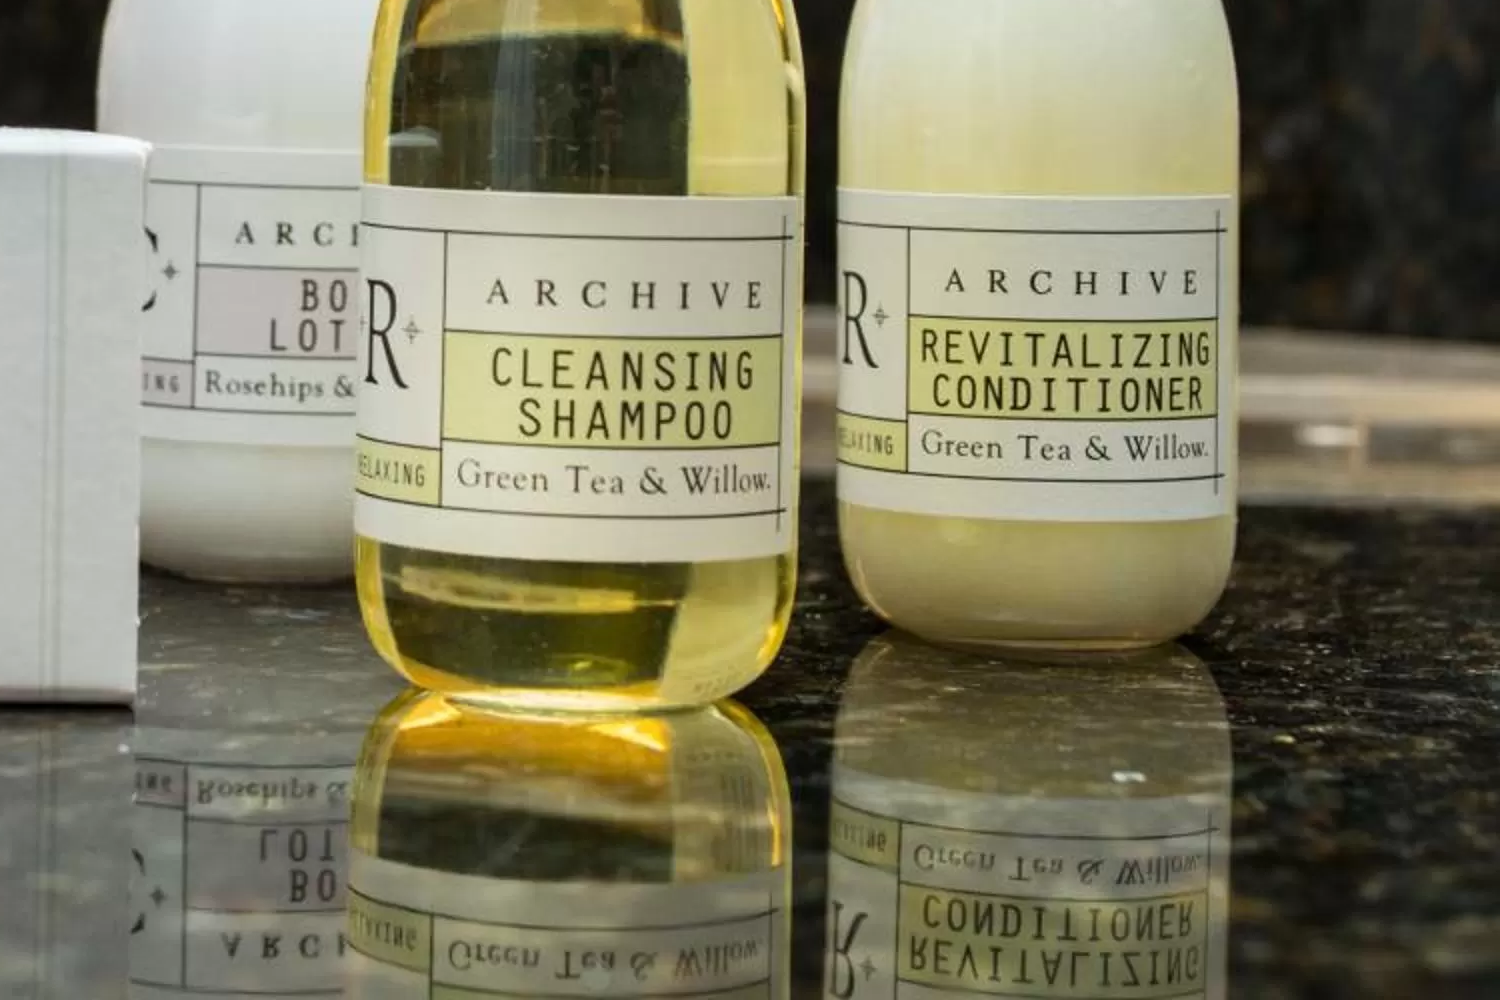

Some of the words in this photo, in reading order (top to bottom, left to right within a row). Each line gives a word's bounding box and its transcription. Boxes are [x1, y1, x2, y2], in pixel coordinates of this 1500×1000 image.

[301, 279, 348, 312] BO
[486, 279, 762, 310] ARCHIVE
[944, 268, 1198, 296] ARCHIVE
[270, 318, 345, 352] LOT
[364, 278, 409, 389] R
[842, 271, 879, 368] R
[920, 328, 1210, 369] REVITALIZING
[205, 370, 324, 403] Rosehips
[334, 374, 356, 398] &
[492, 347, 754, 391] CLEANSING
[933, 373, 1203, 412] CONDITIONER
[519, 398, 732, 440] SHAMPOO
[921, 430, 1003, 459] Green
[1017, 435, 1071, 461] Tea
[1084, 436, 1113, 462] &
[1124, 433, 1209, 461] Willow.
[457, 458, 548, 492] Green
[565, 465, 623, 495] Tea
[639, 466, 668, 496] &
[680, 464, 771, 495] Willow.
